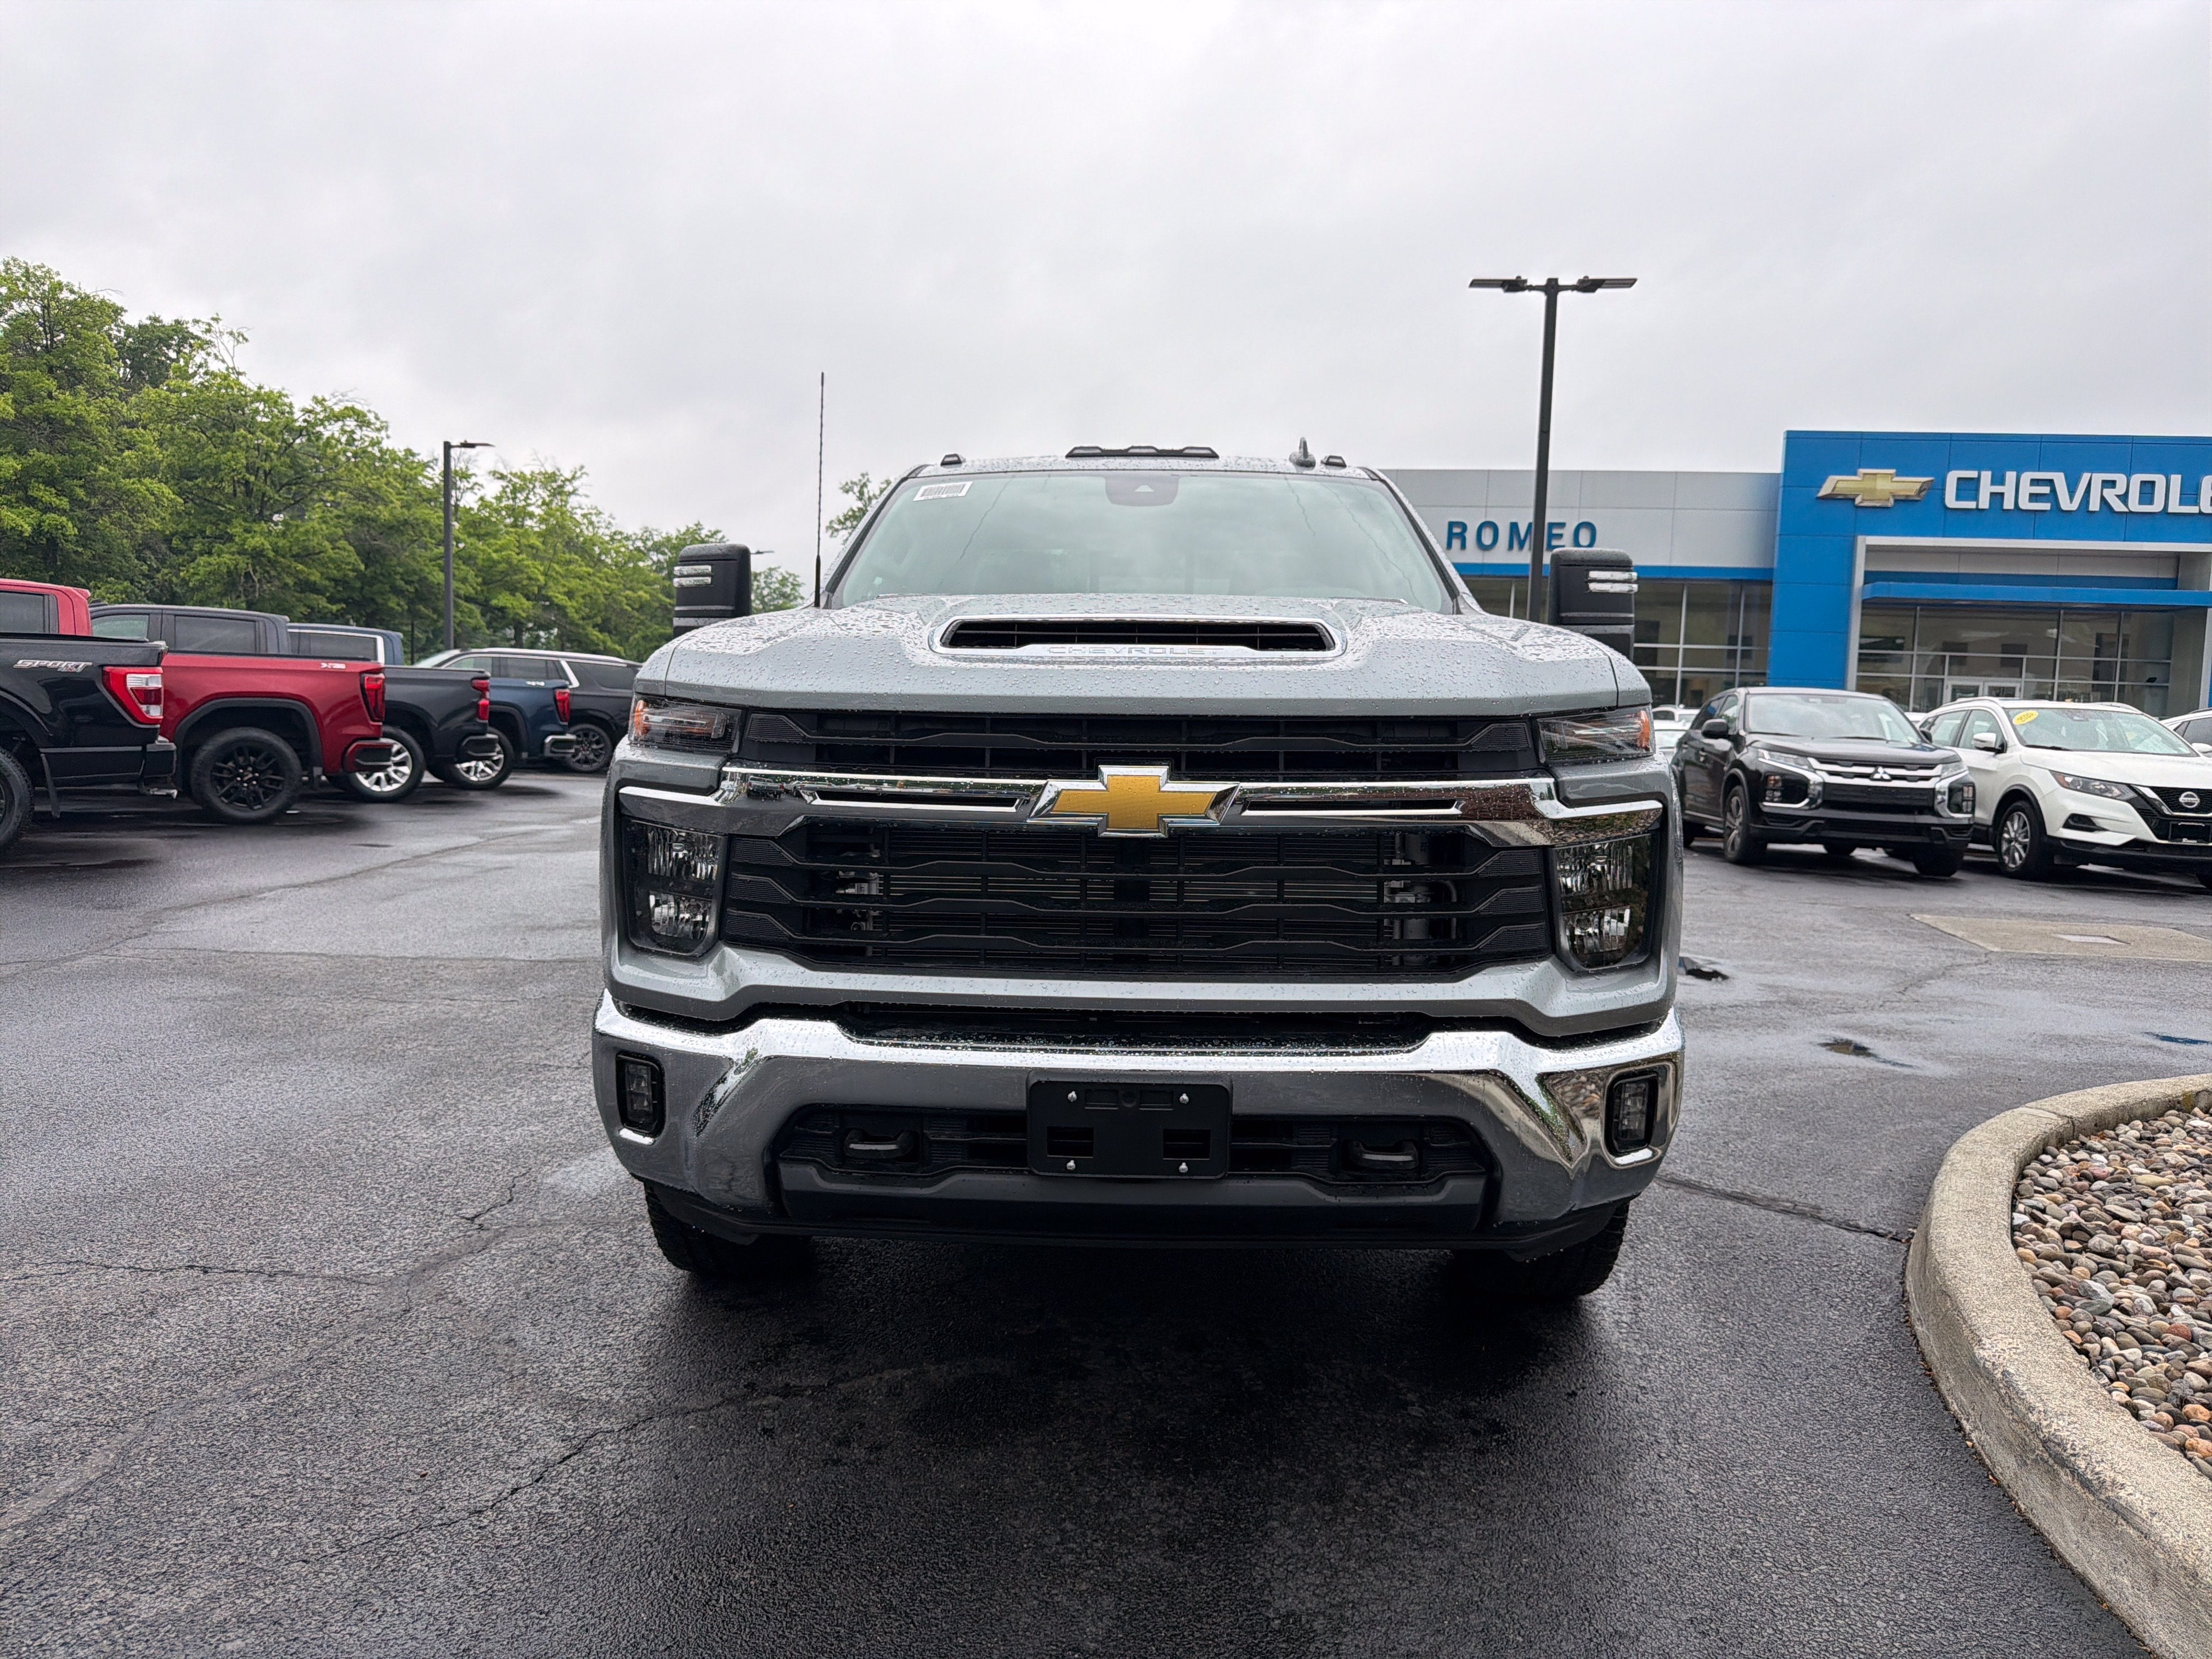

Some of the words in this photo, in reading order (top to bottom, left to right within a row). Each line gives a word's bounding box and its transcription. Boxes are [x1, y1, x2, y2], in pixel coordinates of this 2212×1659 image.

[1446, 521, 1597, 551] ROMEO
[1047, 646, 1224, 655] CHEVROLET
[13, 659, 93, 673] SPORT
